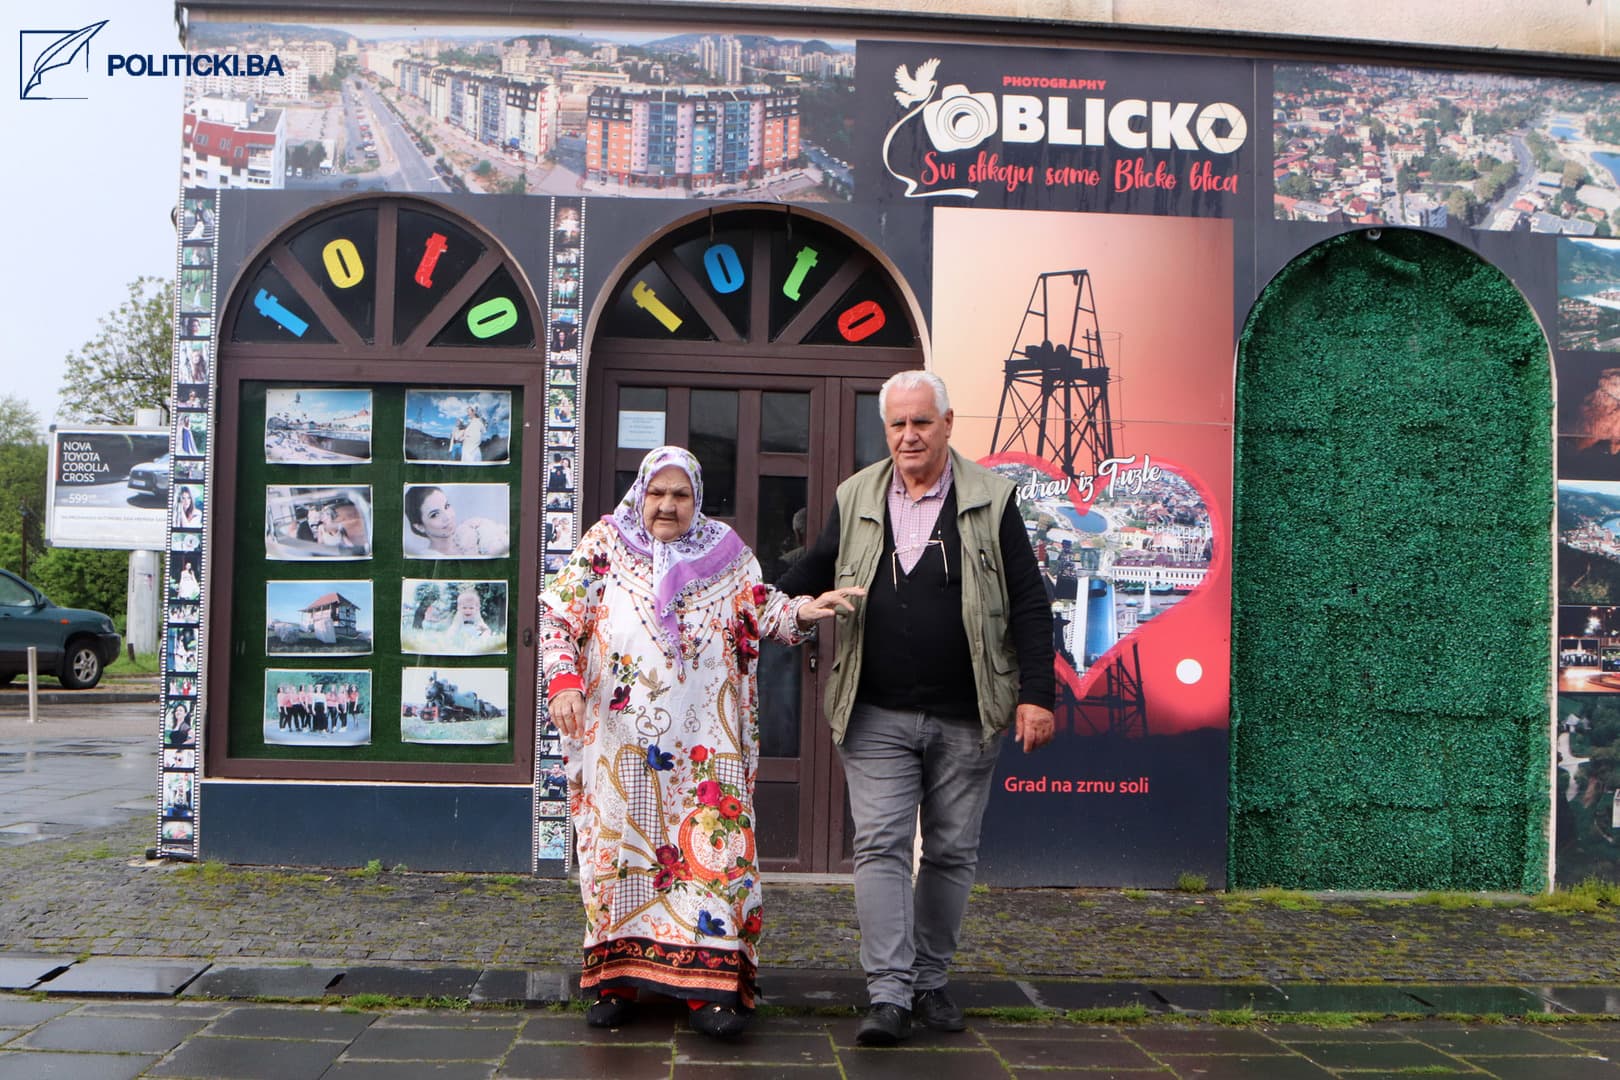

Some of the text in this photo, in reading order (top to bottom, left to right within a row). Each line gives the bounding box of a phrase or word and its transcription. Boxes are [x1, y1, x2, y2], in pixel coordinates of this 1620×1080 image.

[1002, 76, 1106, 90] PHOTOGRAPHY
[1002, 94, 1248, 154] BLICKO
[920, 151, 956, 186] Svi
[1045, 166, 1101, 187] samo
[1114, 157, 1176, 193] Blicko
[1189, 160, 1238, 193] blica
[63, 442, 92, 451] NOVA
[63, 452, 101, 462] TOYOTA
[62, 462, 110, 472] COROLLA
[62, 473, 95, 482] CROSS
[1078, 471, 1094, 502] iz
[1098, 454, 1162, 498] Tuzle
[68, 493, 89, 504] 599
[1004, 776, 1149, 794] Grad na zrnu soli
